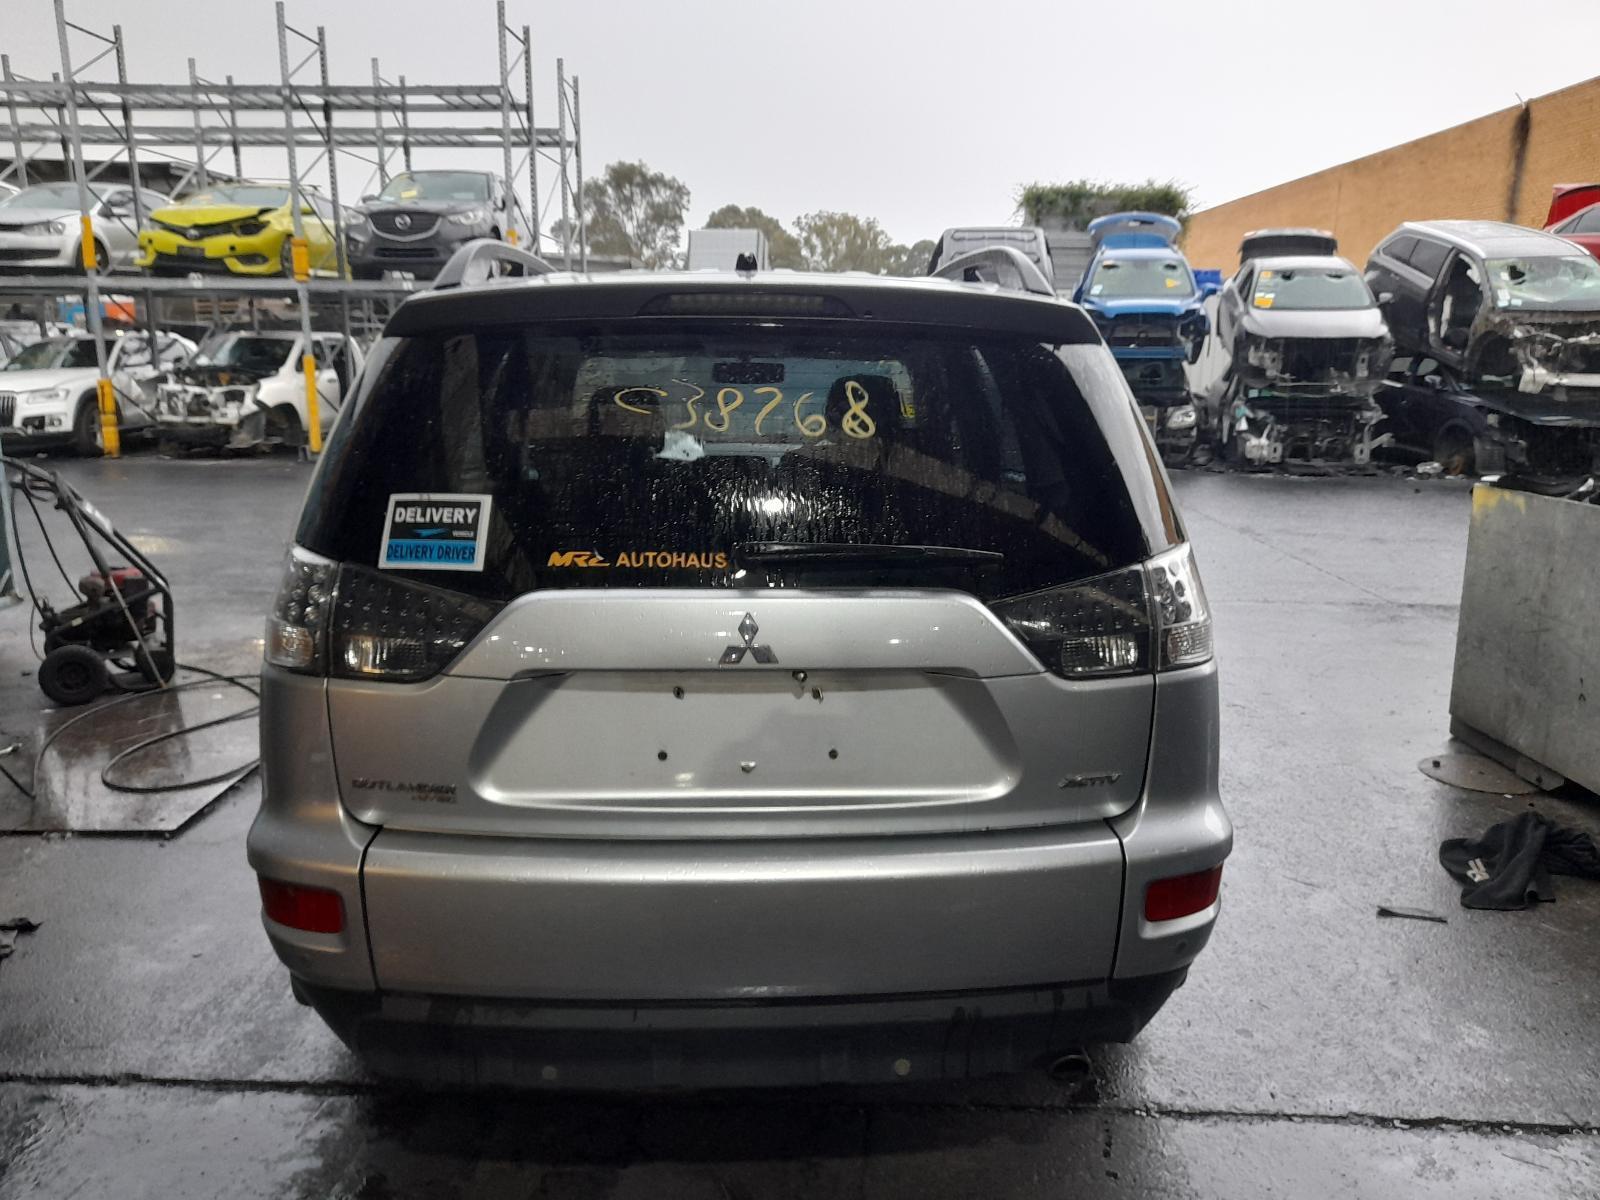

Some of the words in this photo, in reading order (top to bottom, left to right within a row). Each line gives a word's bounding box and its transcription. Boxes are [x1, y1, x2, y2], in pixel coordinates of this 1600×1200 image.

[394, 506, 478, 525] DELIVERY
[386, 543, 435, 560] DELIVERY
[437, 545, 477, 562] DRIVER
[615, 551, 728, 569] AUTOHAUS
